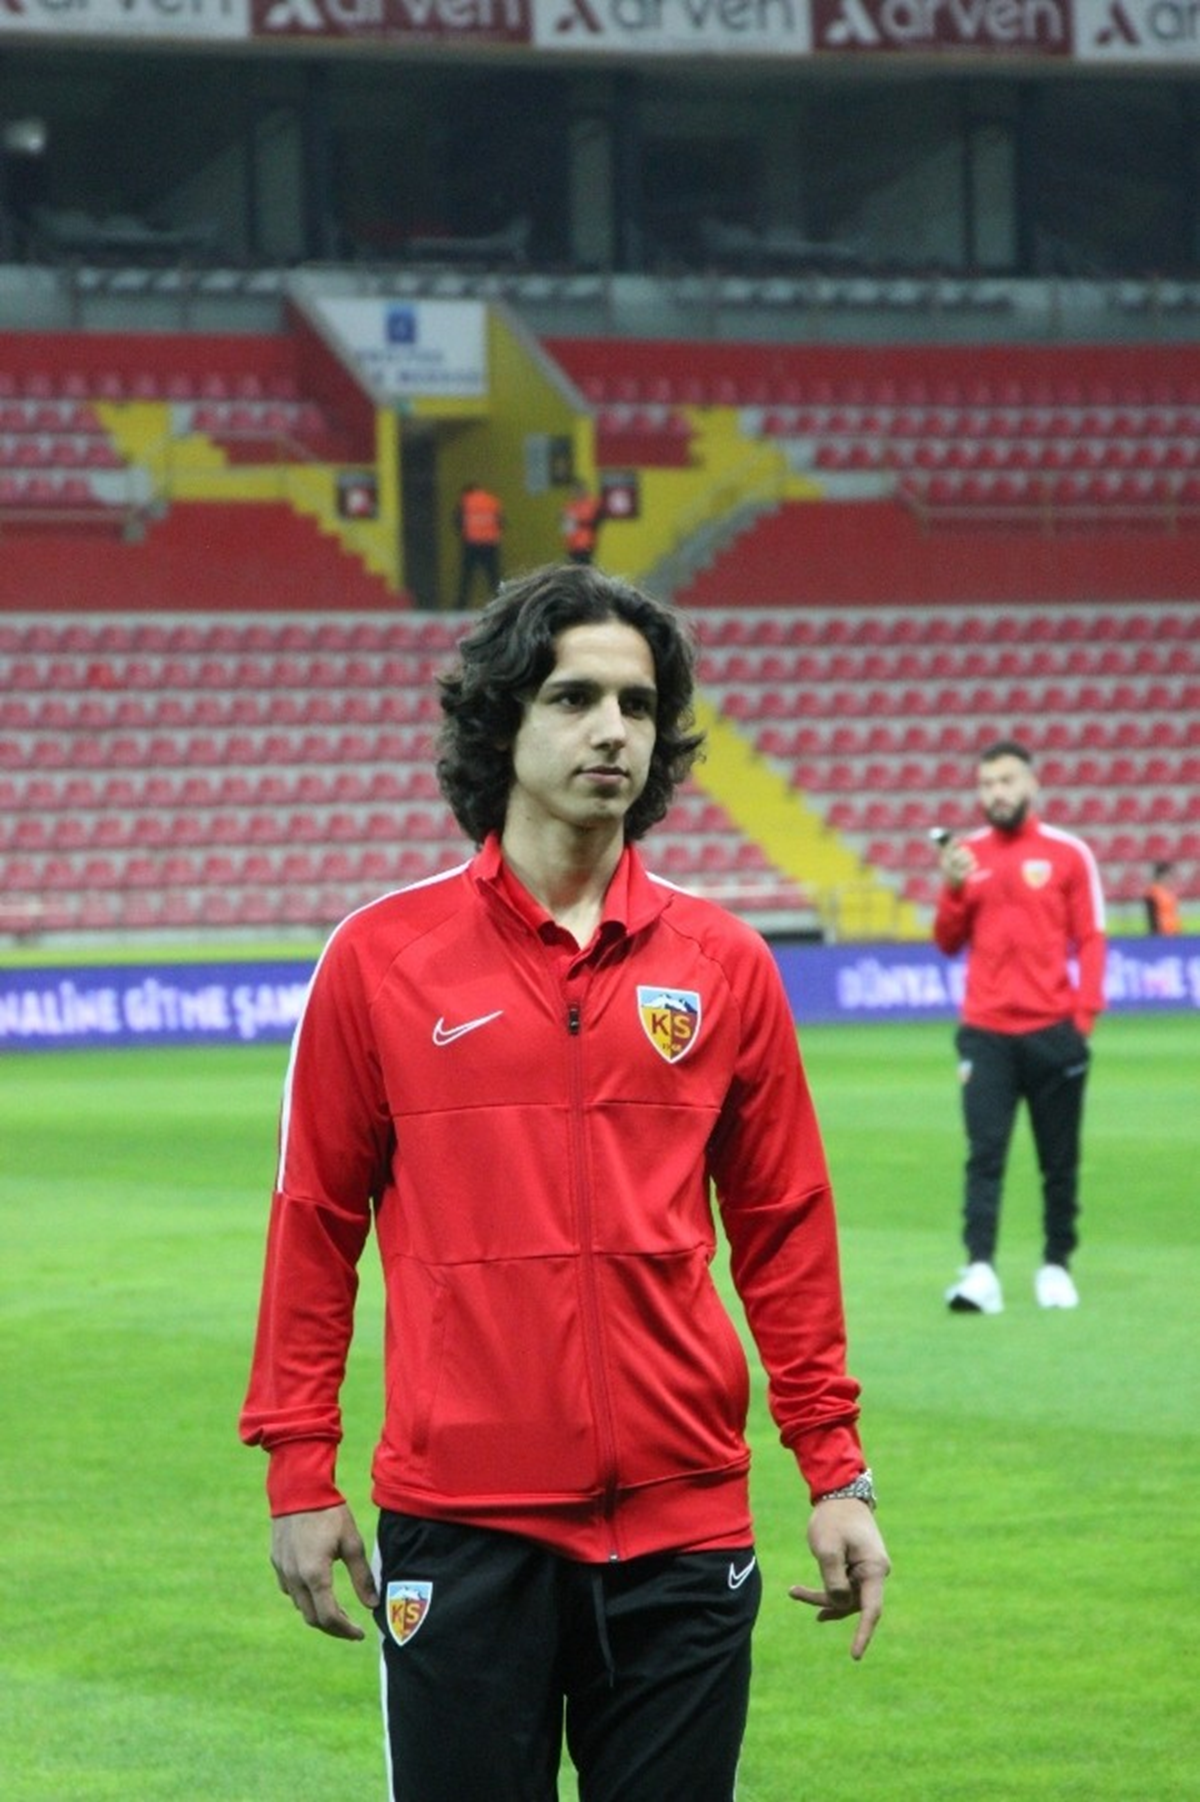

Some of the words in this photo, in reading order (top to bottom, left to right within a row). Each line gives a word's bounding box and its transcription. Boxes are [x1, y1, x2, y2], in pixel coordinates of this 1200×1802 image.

[881, 0, 1064, 41] arven
[651, 1013, 692, 1039] KS
[391, 1603, 420, 1624] KS
